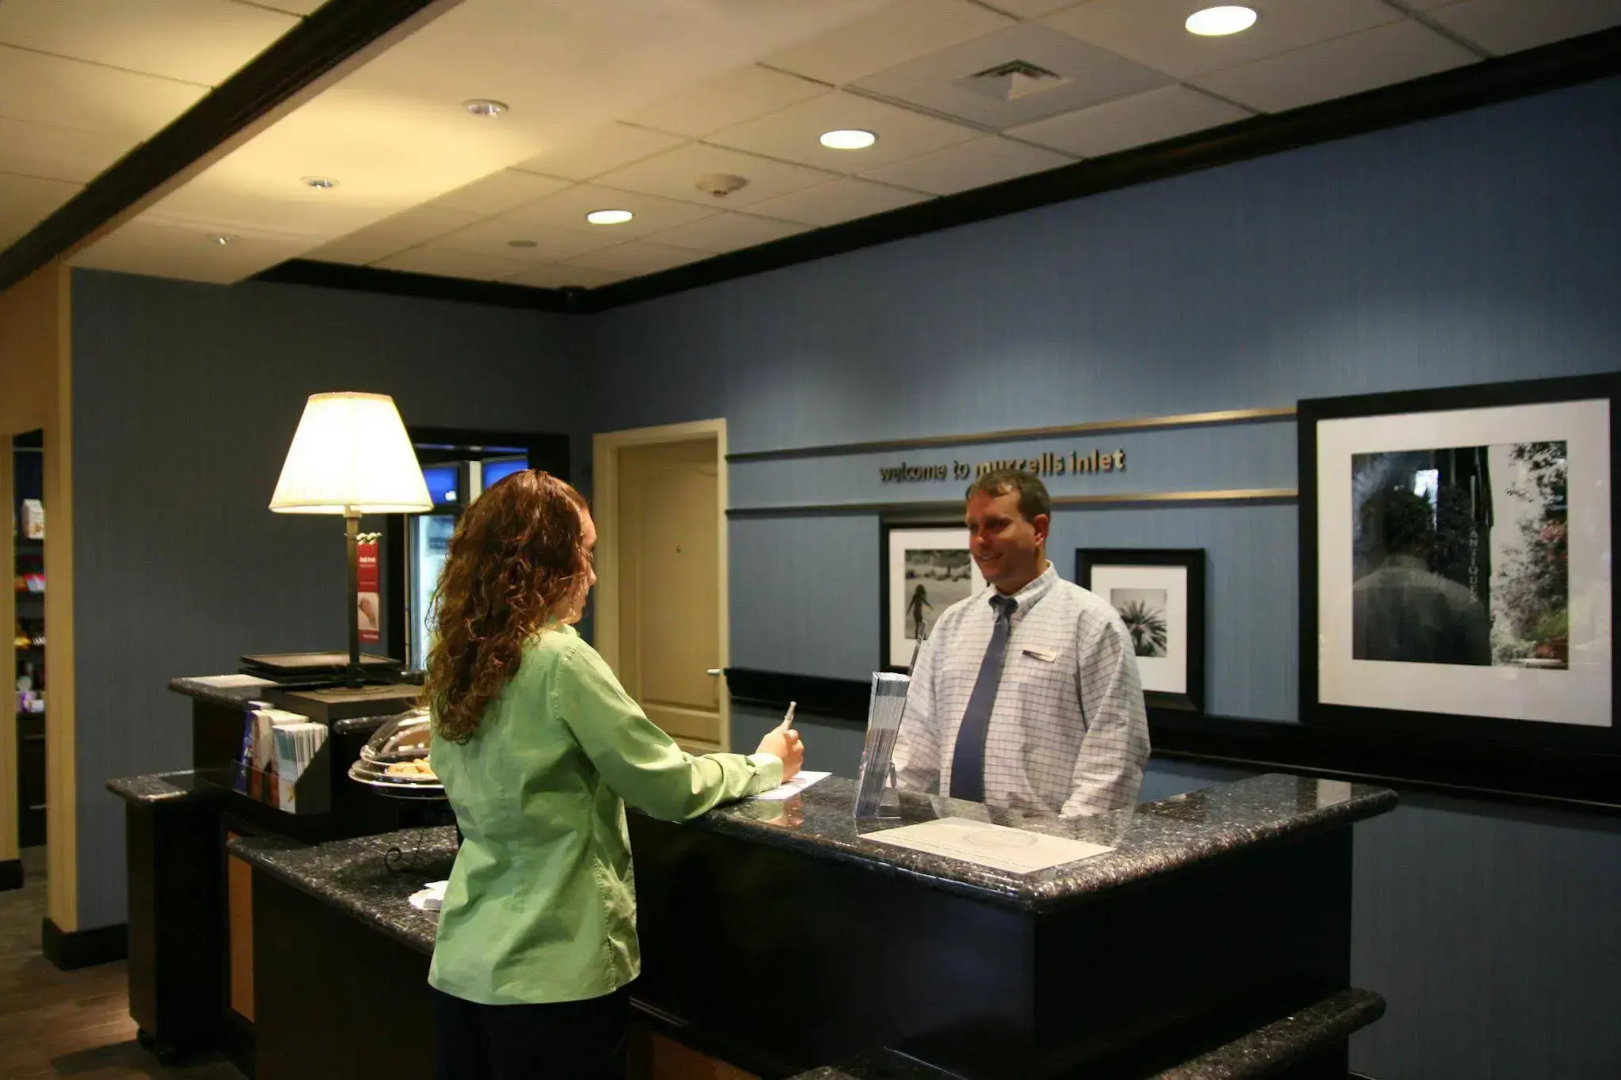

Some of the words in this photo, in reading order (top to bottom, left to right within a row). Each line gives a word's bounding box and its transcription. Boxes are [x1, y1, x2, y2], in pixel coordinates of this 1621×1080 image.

[880, 461, 947, 482] welcome
[954, 460, 970, 480] to
[1069, 449, 1126, 474] inlet
